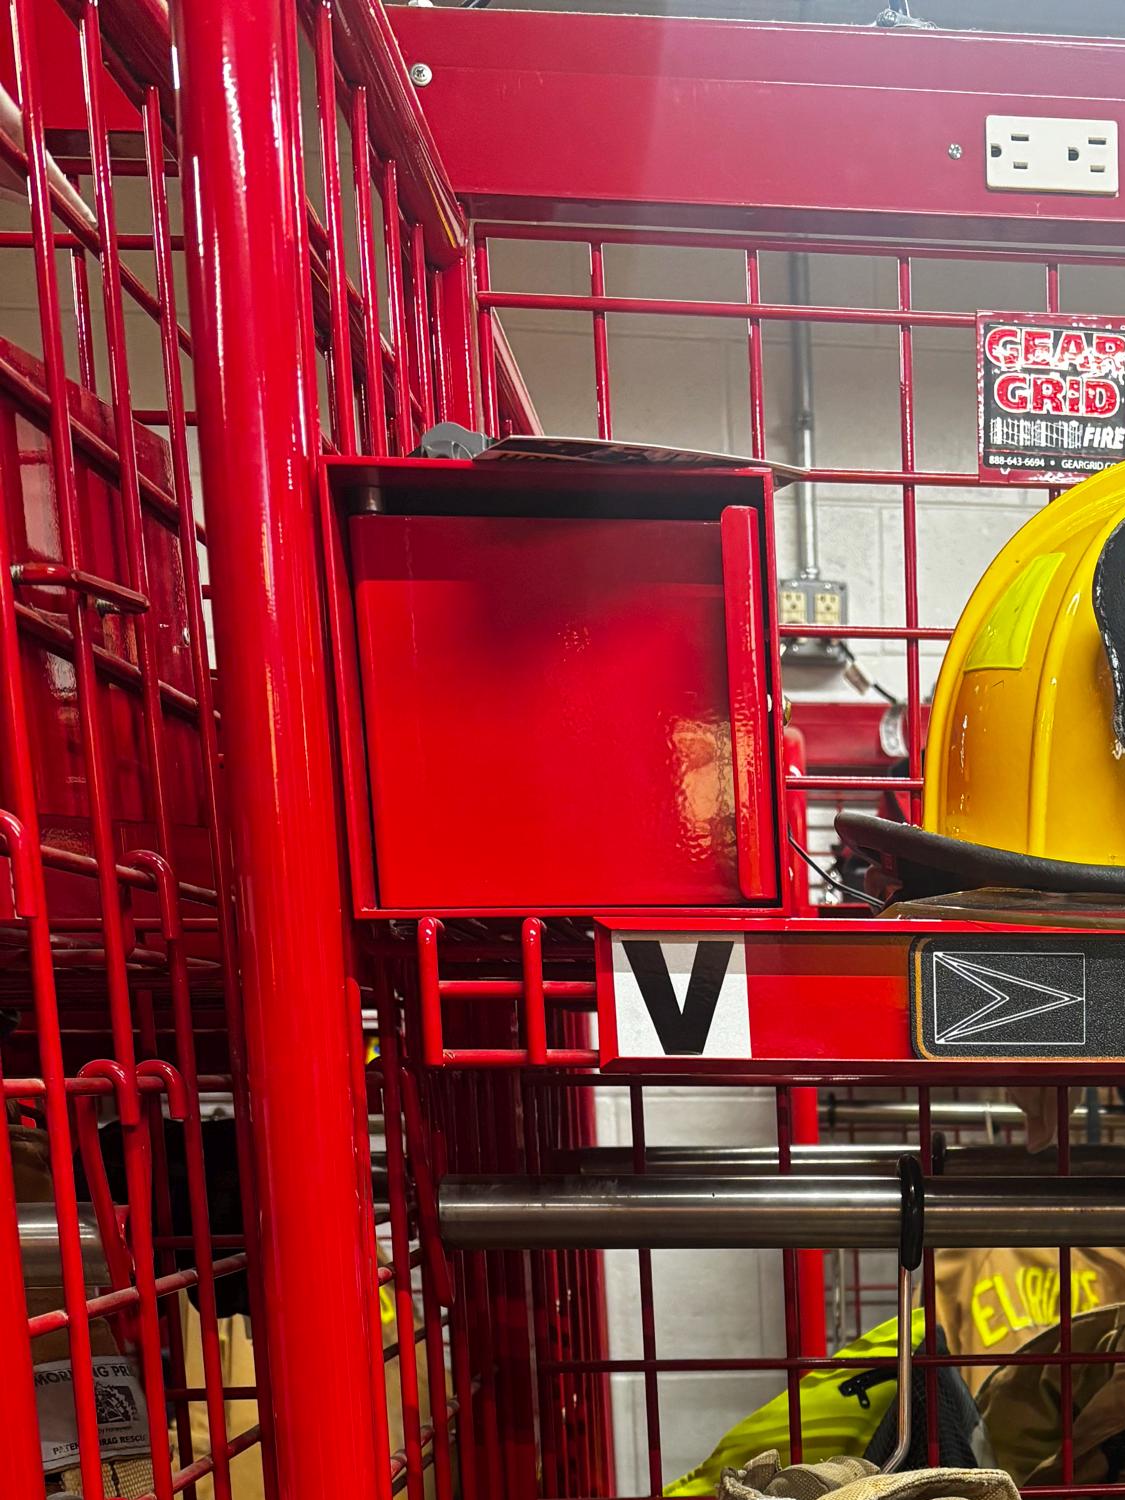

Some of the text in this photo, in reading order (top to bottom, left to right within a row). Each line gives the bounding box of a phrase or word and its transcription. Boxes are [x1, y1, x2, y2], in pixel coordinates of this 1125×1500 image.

[994, 373, 1121, 419] GRID
[1083, 426, 1125, 450] FIRE
[988, 454, 1046, 468] 888-643-6694
[621, 940, 735, 1056] V
